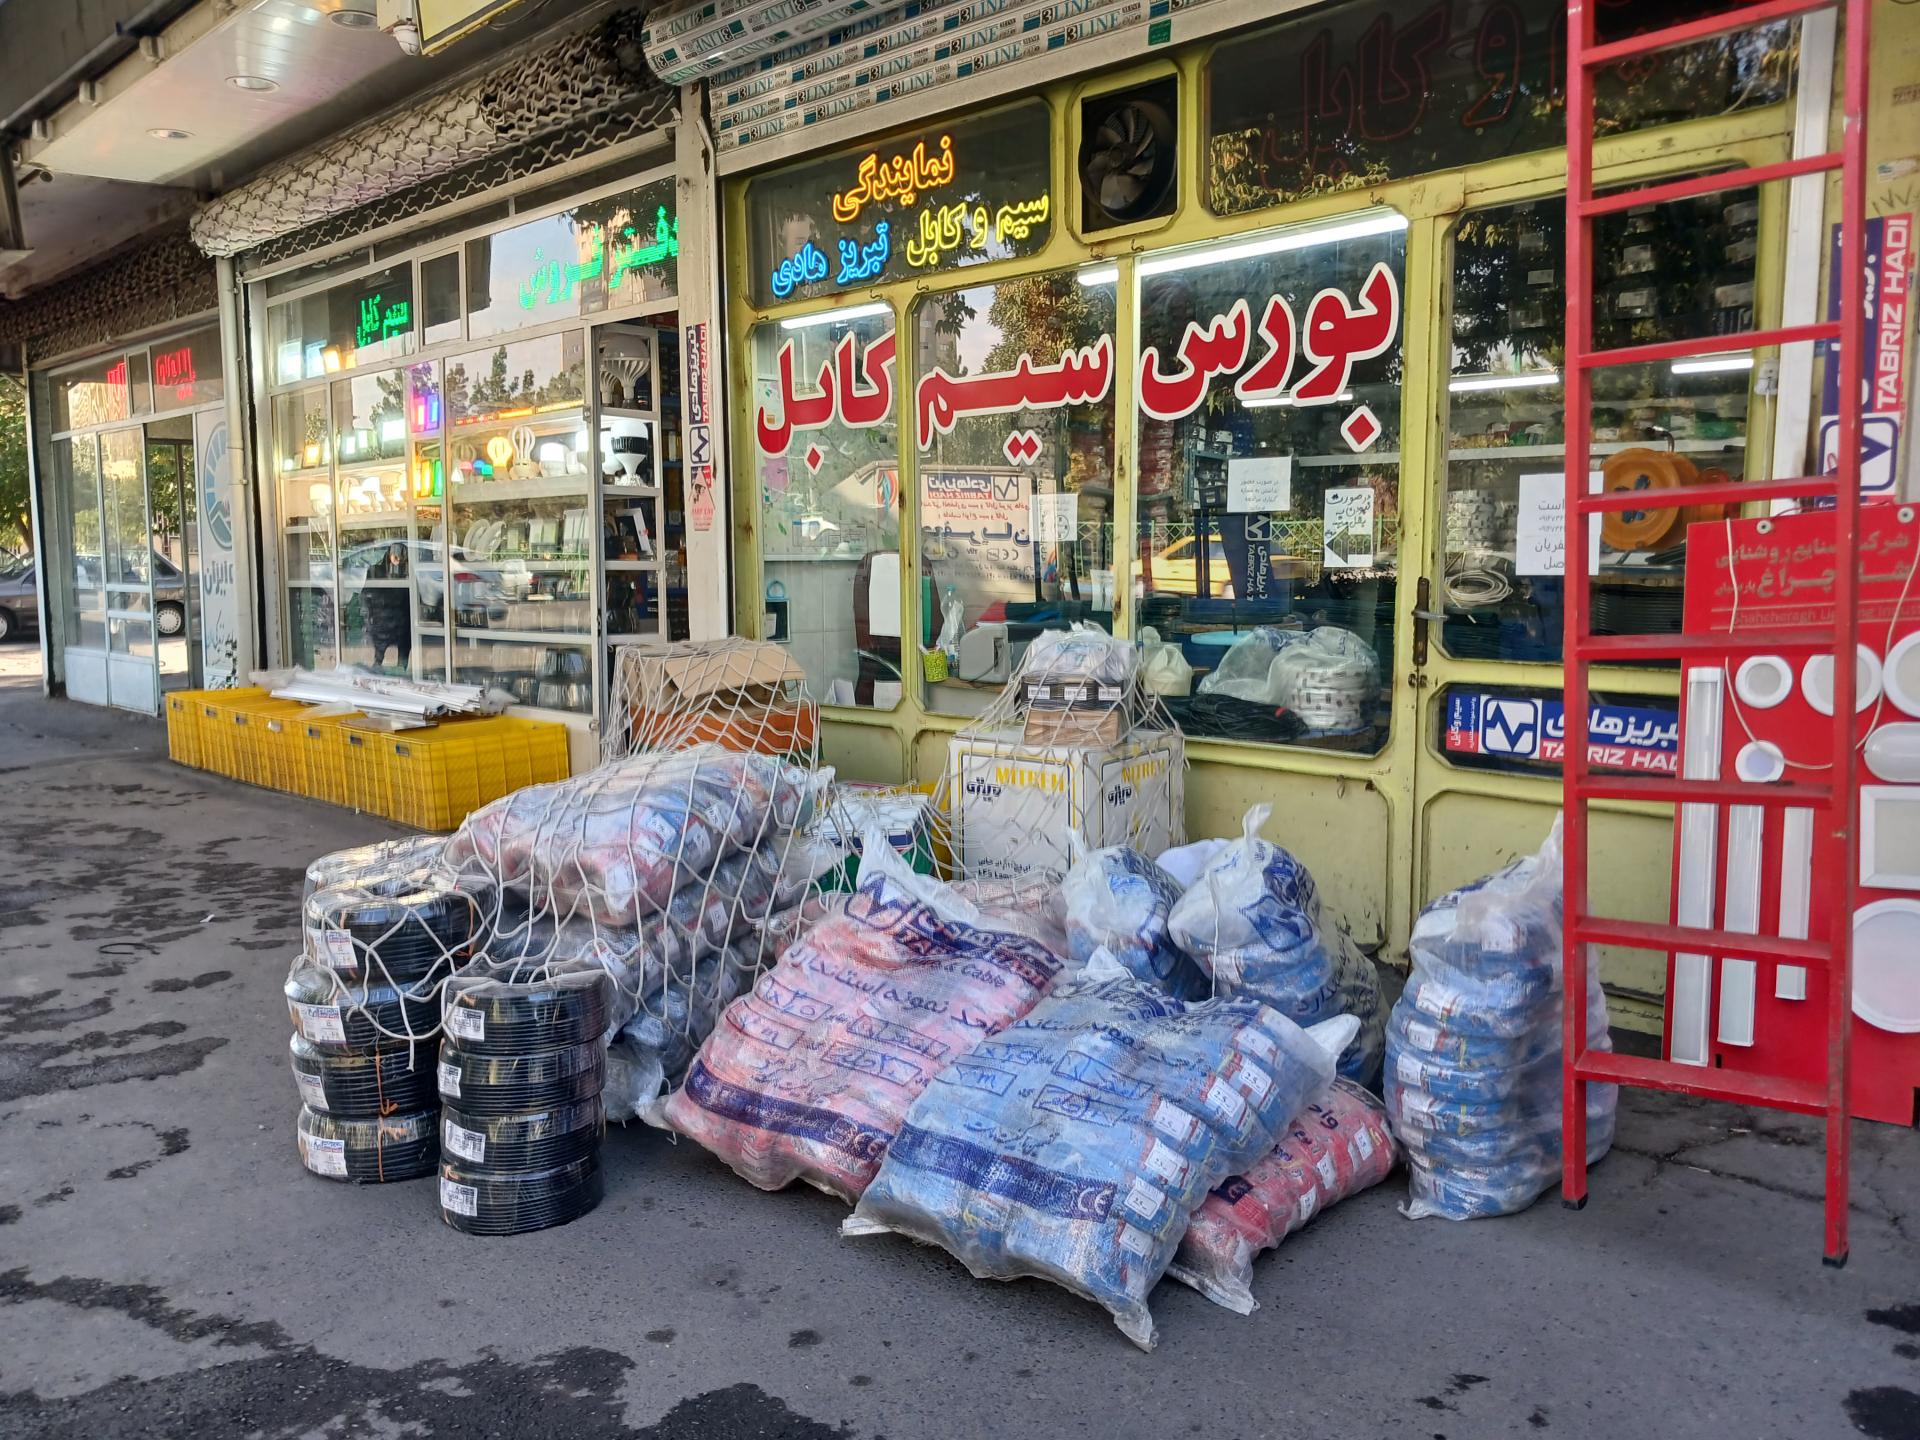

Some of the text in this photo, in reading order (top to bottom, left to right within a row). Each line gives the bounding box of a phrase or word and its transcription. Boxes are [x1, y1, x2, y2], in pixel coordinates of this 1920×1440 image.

[878, 25, 921, 51] 3LINE
[951, 24, 999, 54] 3LINE
[1066, 11, 1121, 42] 3LINE
[804, 51, 844, 78] 3LINE
[871, 55, 912, 80] 3LINE
[973, 41, 1024, 71] 3LINE
[738, 75, 774, 99] 3LINE
[797, 80, 835, 105] 3LINE
[891, 70, 933, 97] 3LINE
[732, 103, 768, 125] 3LINE
[817, 96, 856, 119] 3LINE
[750, 116, 787, 142] 3LINE
[832, 134, 954, 223] نمایندگی
[906, 193, 1050, 267] سیم و کابل
[518, 225, 604, 310] فروش
[771, 218, 890, 298] تبریز هادی
[1877, 218, 1909, 409] TABRIZ HADI
[755, 261, 1400, 473] بورس سیم کابل
[1326, 492, 1362, 506] صورت
[1543, 741, 1626, 767] TARIZ
